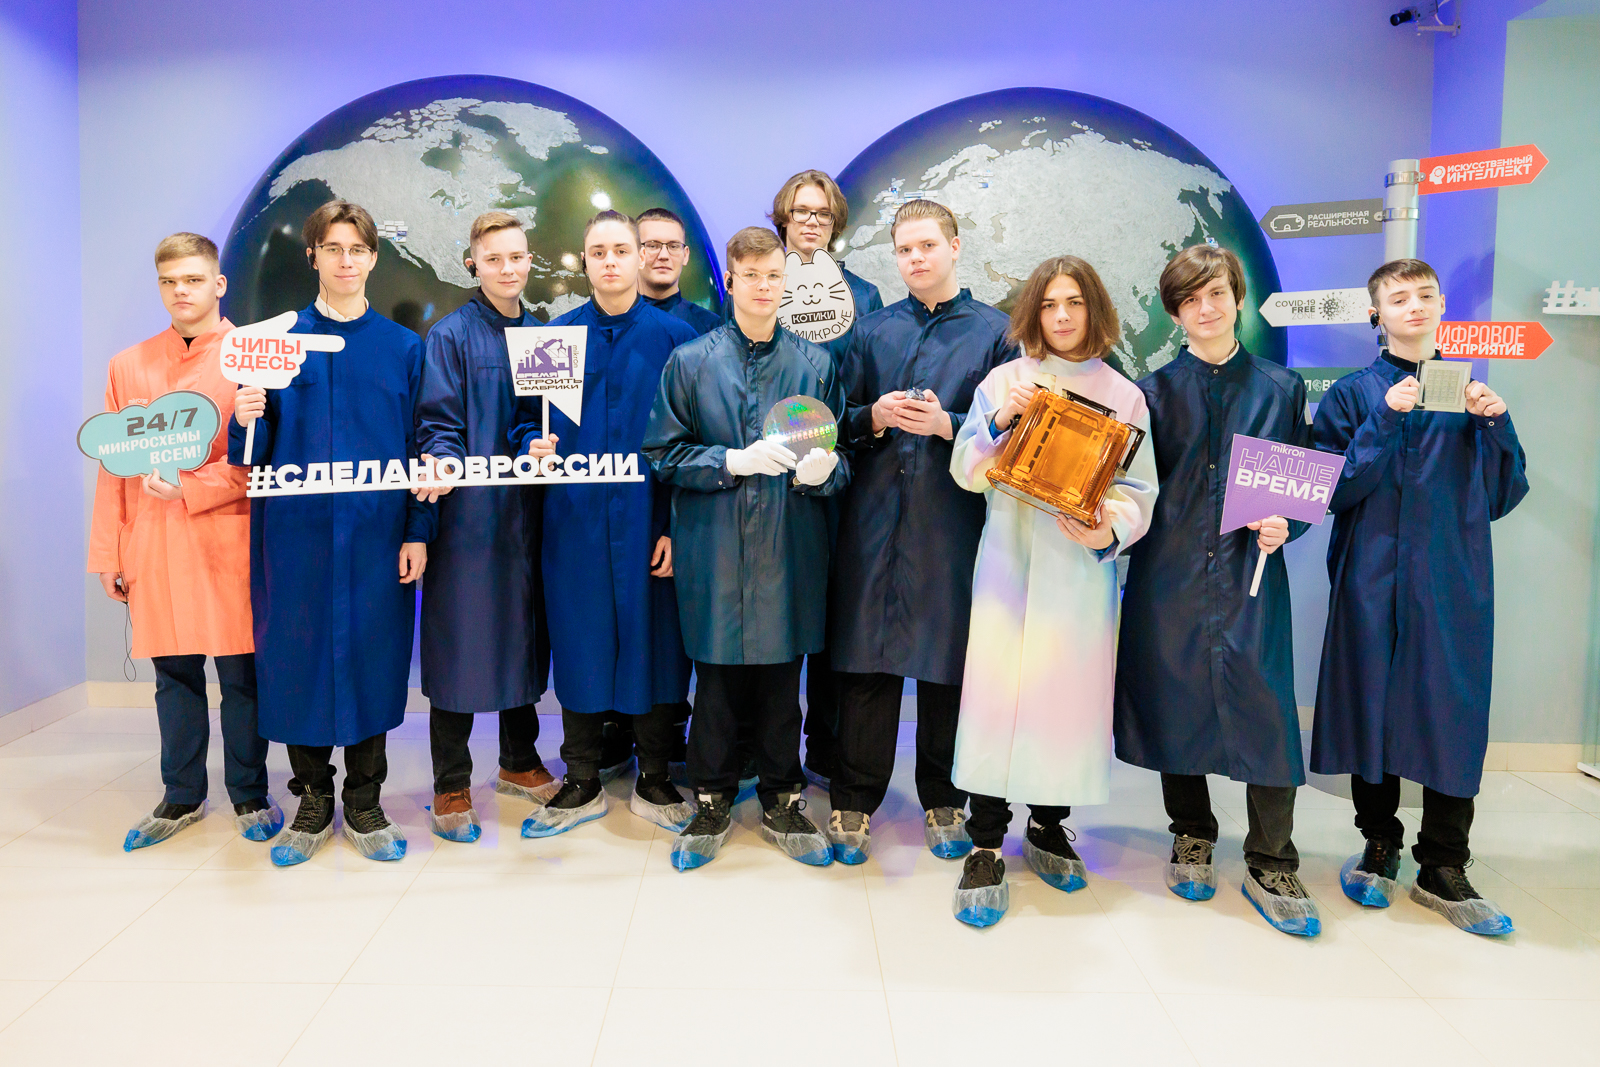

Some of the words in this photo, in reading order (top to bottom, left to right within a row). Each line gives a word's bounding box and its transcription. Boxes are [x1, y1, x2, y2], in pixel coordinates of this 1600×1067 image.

[1447, 154, 1533, 172] ИСКУССТВЕННЫЙ
[1446, 163, 1532, 183] ИНТЕЛЛЕКТ
[1307, 210, 1370, 220] РАСШИРЕННАЯ
[1307, 217, 1369, 228] РЕАЛЬНОСТЬ
[1275, 299, 1316, 308] COVID-19
[1291, 305, 1316, 314] FREE
[792, 311, 836, 324] КОТИКИ
[1291, 312, 1316, 320] ZONE
[1434, 324, 1526, 345] ИФРОВОЕ
[231, 337, 301, 355] ЧИПЫ
[1434, 342, 1525, 356] РЕДПРИЯТИЕ
[224, 354, 297, 372] ЗДЕСЬ
[126, 407, 199, 437] 24/7
[98, 430, 201, 456] МИКРОСХЕМЫ
[1270, 444, 1305, 458] mikron
[149, 445, 202, 465] ВСЕМ!
[246, 453, 641, 492] #СДЕЛАНОВРОССИИ
[1239, 448, 1335, 487] НАШЕ
[1234, 467, 1330, 504] ВРЕМЯ
